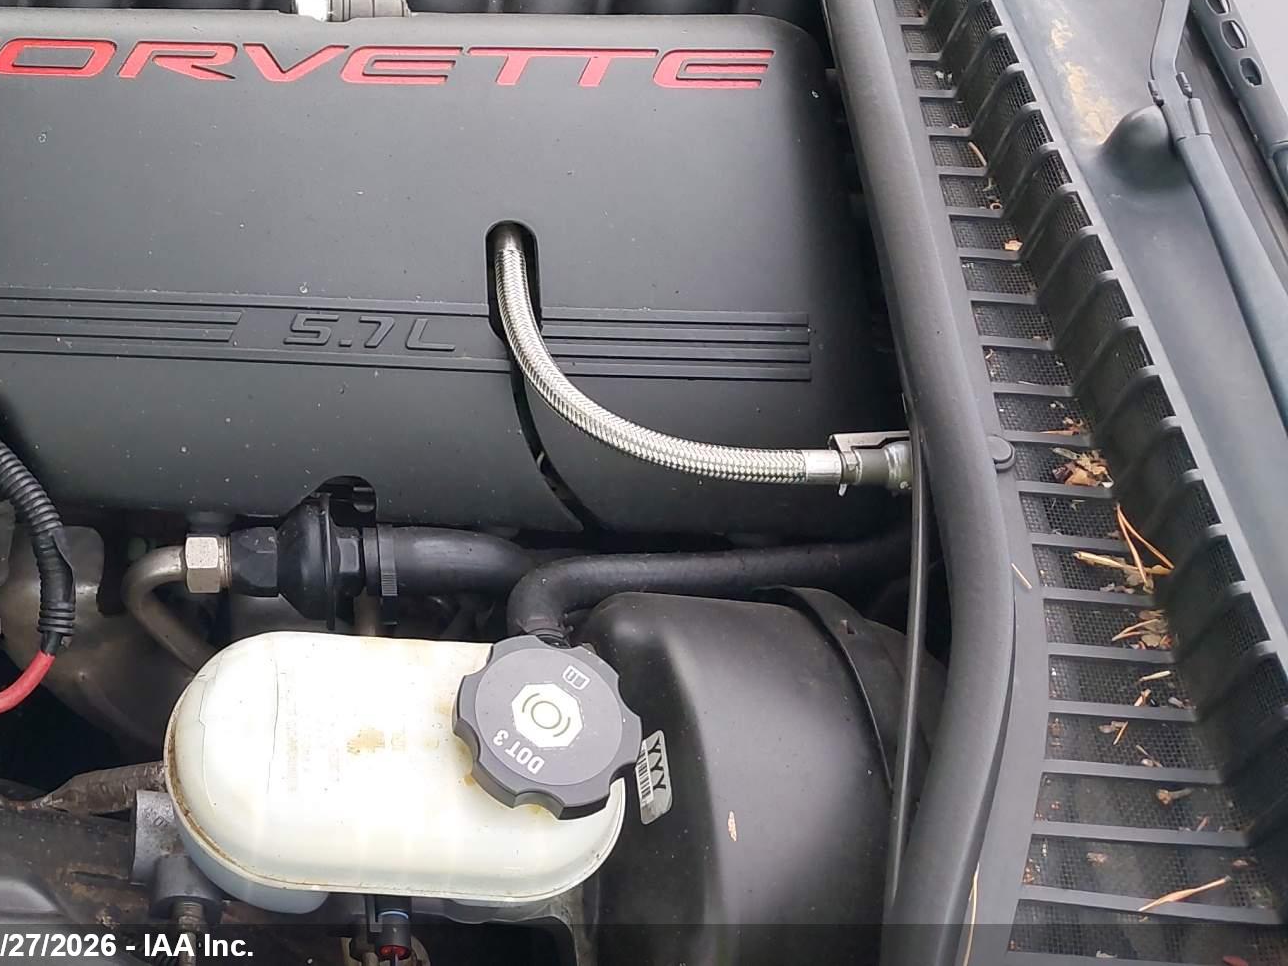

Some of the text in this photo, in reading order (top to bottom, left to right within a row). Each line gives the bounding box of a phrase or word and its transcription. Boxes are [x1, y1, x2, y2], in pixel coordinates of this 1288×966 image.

[283, 312, 456, 352] 5.7L
[493, 729, 545, 775] DOT 3
[647, 735, 666, 790] YYY
